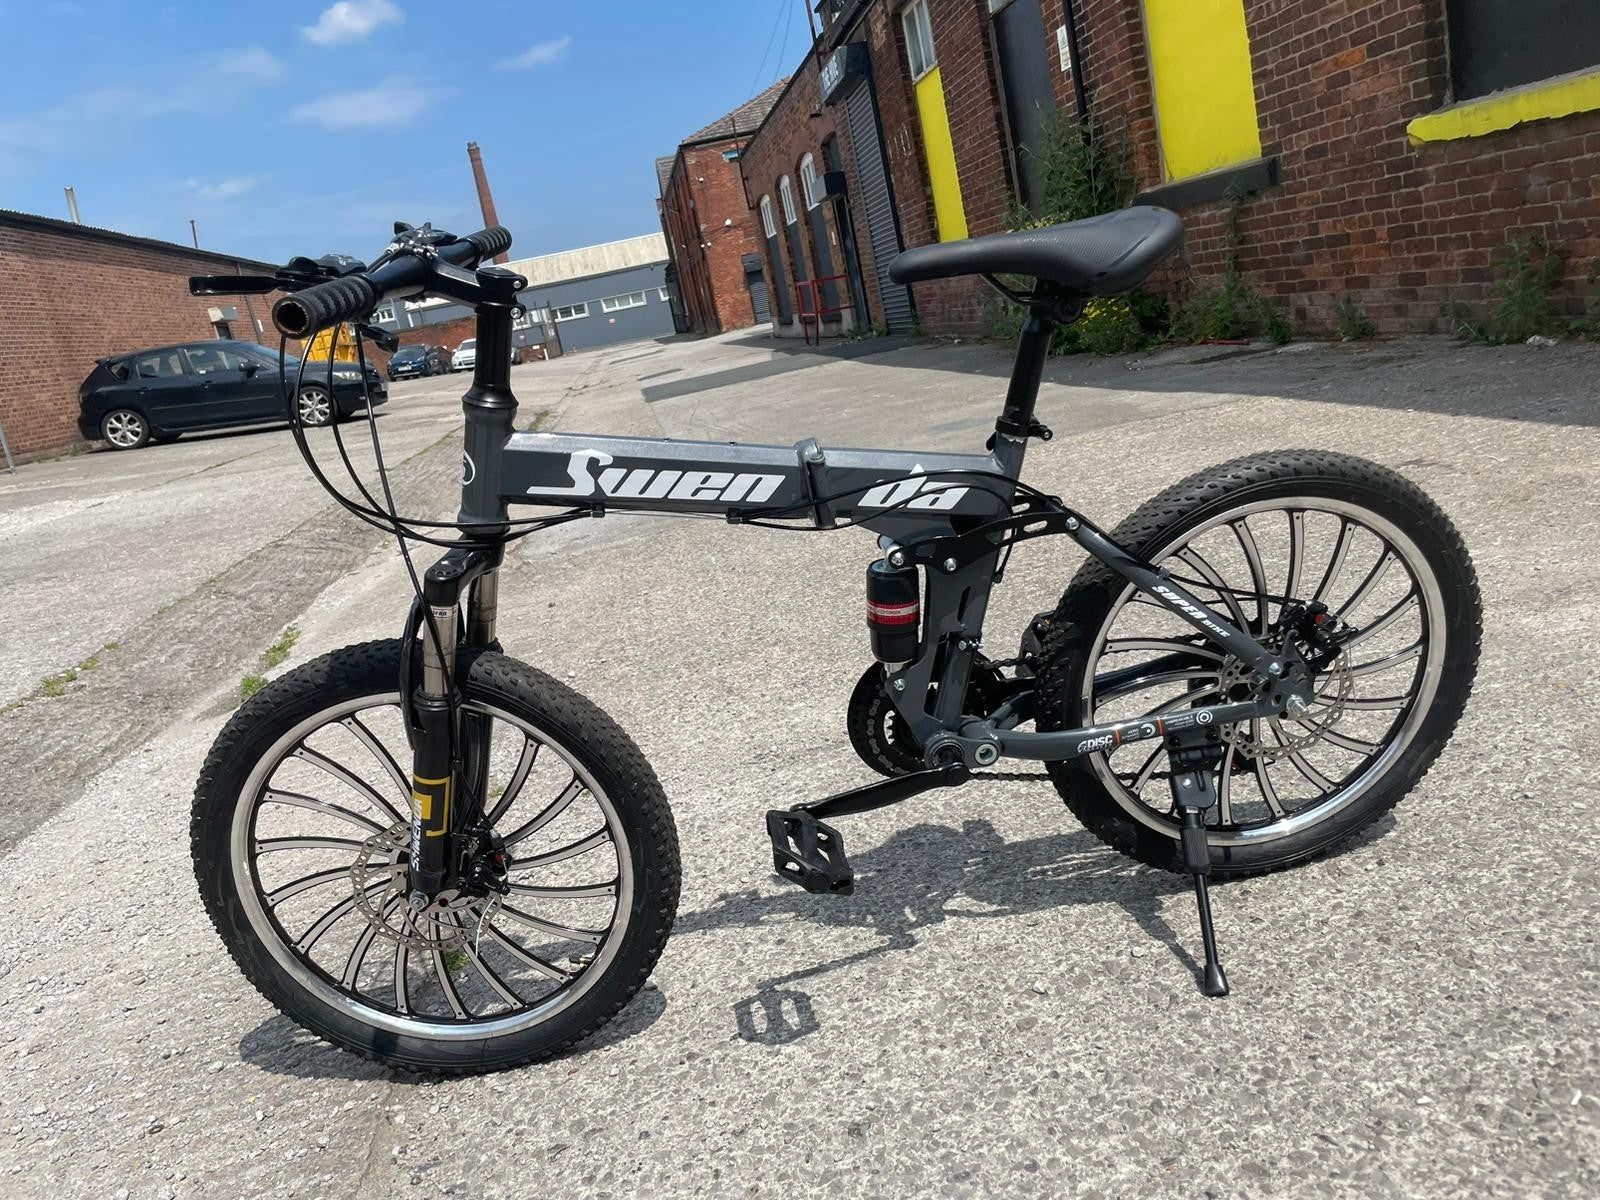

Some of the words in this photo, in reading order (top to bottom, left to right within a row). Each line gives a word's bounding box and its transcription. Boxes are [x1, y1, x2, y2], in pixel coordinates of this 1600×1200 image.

[1152, 585, 1208, 619] SUPER
[1201, 619, 1231, 637] BIKE
[1087, 735, 1113, 748] DISC
